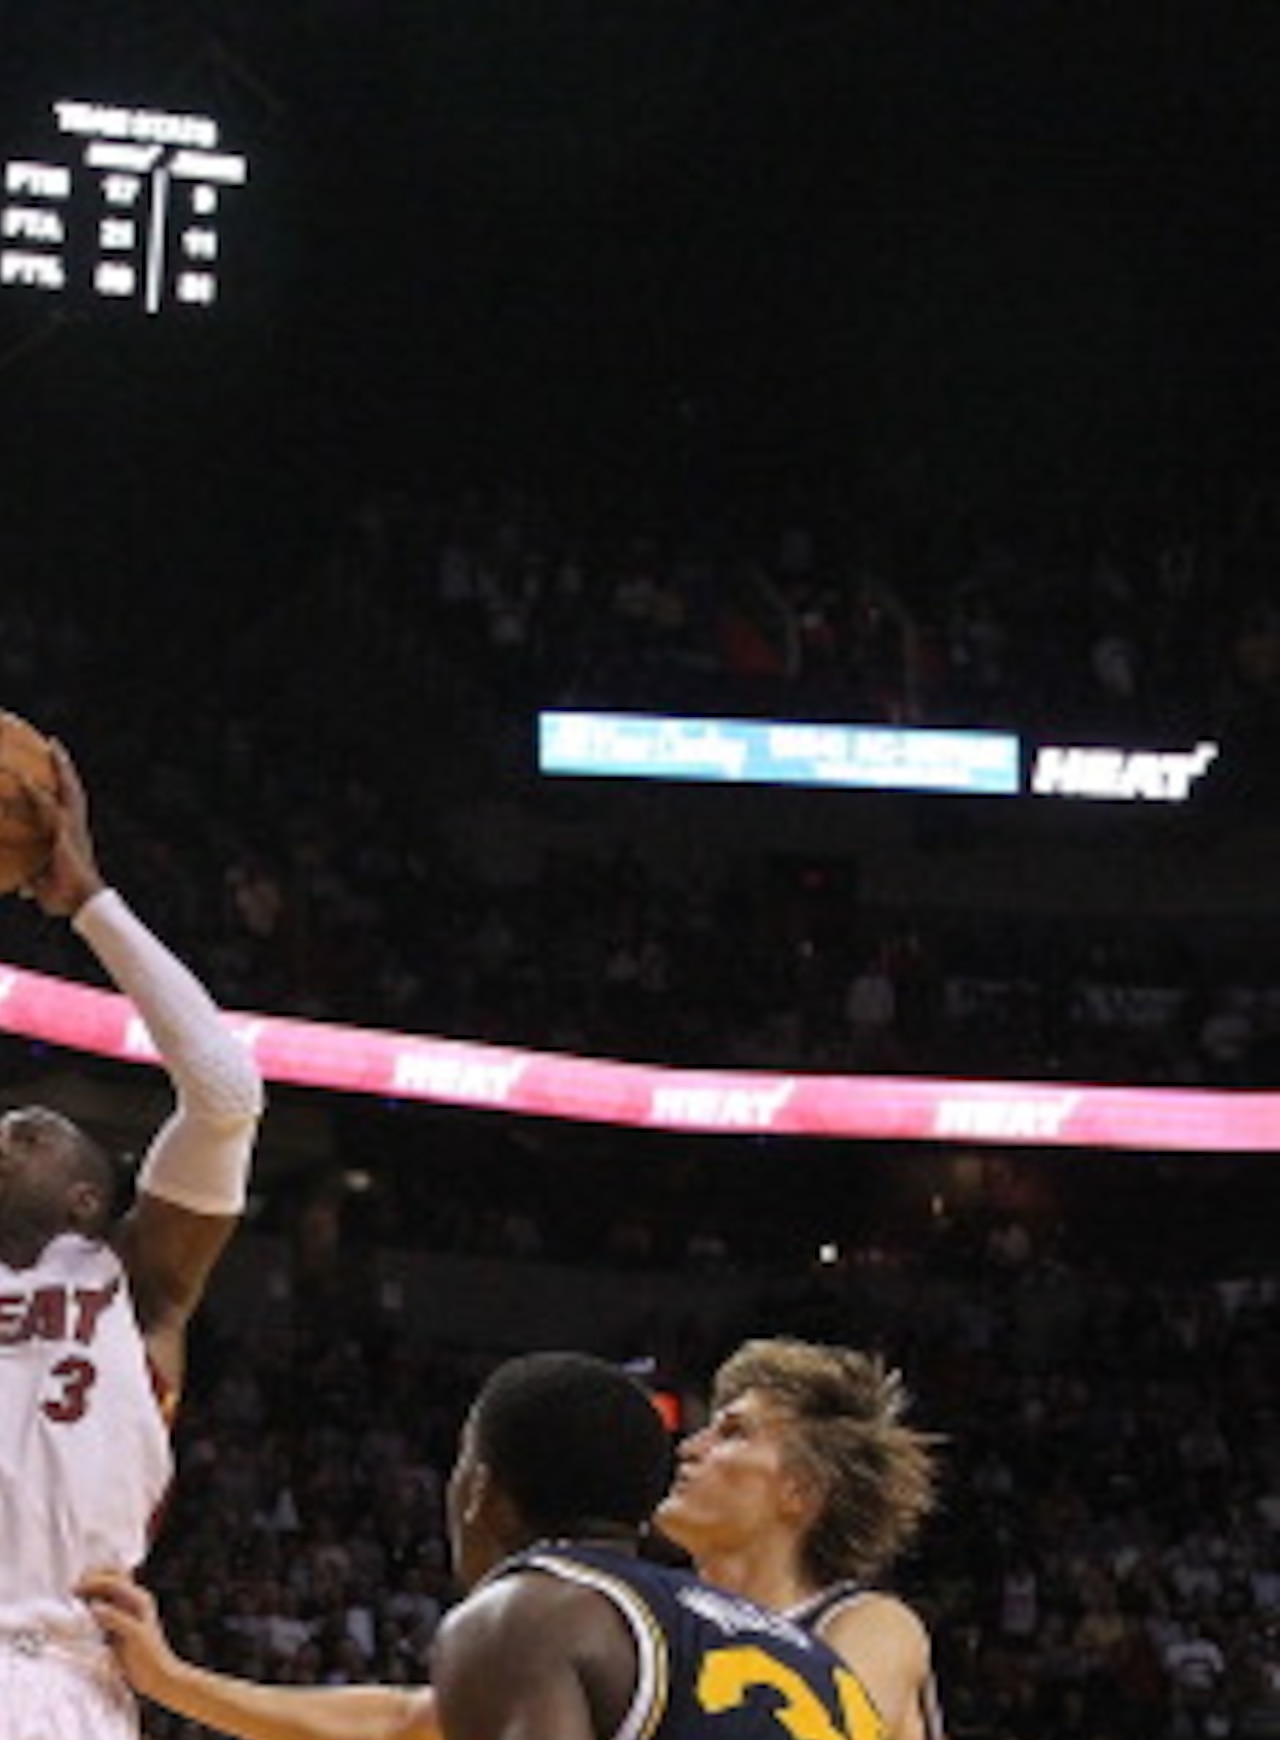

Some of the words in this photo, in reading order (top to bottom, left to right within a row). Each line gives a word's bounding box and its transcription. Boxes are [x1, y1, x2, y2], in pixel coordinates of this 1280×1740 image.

[1032, 742, 1220, 801] HEAT
[392, 1053, 528, 1102] HEAT
[651, 1078, 796, 1127] HEAT
[933, 1091, 1081, 1138] HEAT
[44, 1354, 97, 1423] 3
